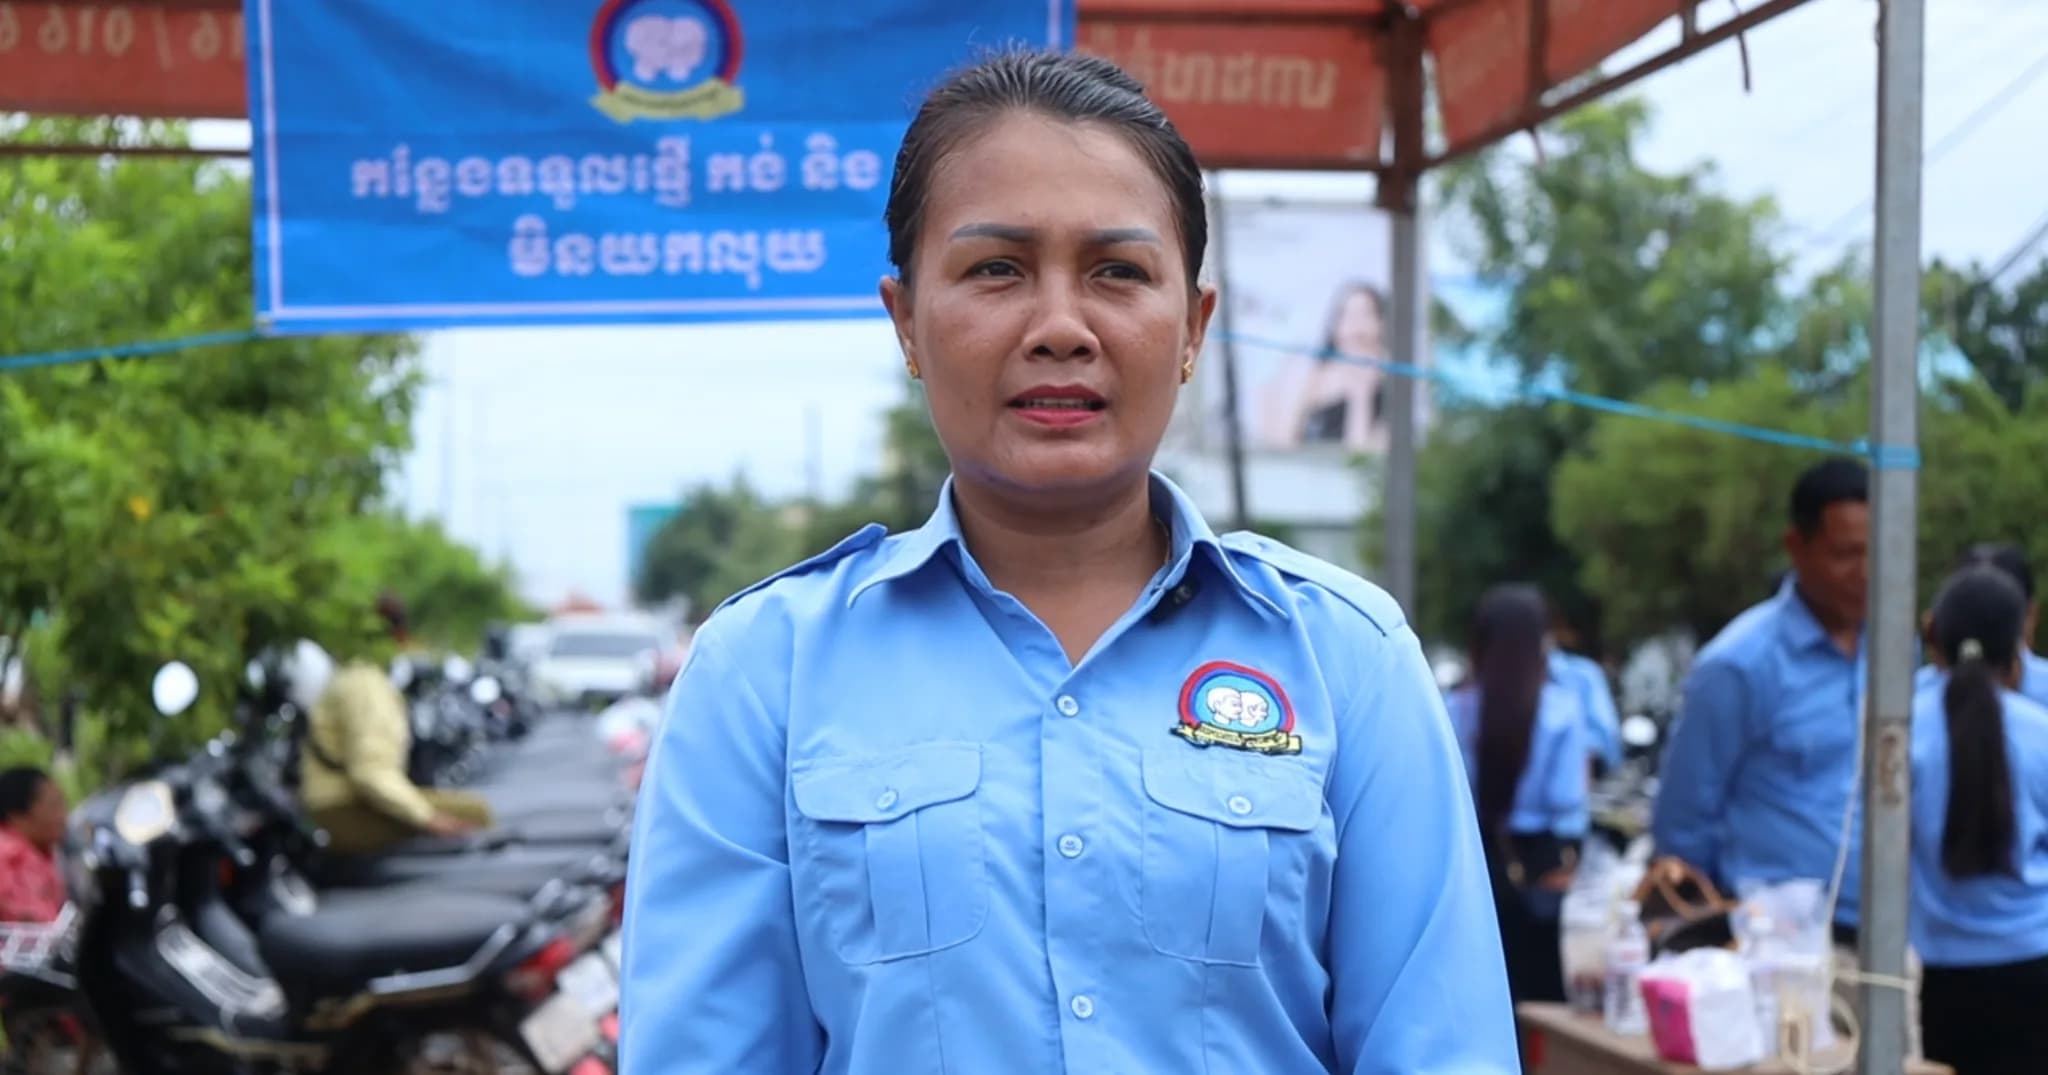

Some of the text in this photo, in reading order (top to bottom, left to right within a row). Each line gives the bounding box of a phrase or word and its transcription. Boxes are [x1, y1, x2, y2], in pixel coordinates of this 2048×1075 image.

[705, 132, 785, 192] កង់
[800, 131, 880, 191] និង
[509, 213, 826, 290] មិនយកលុយ
